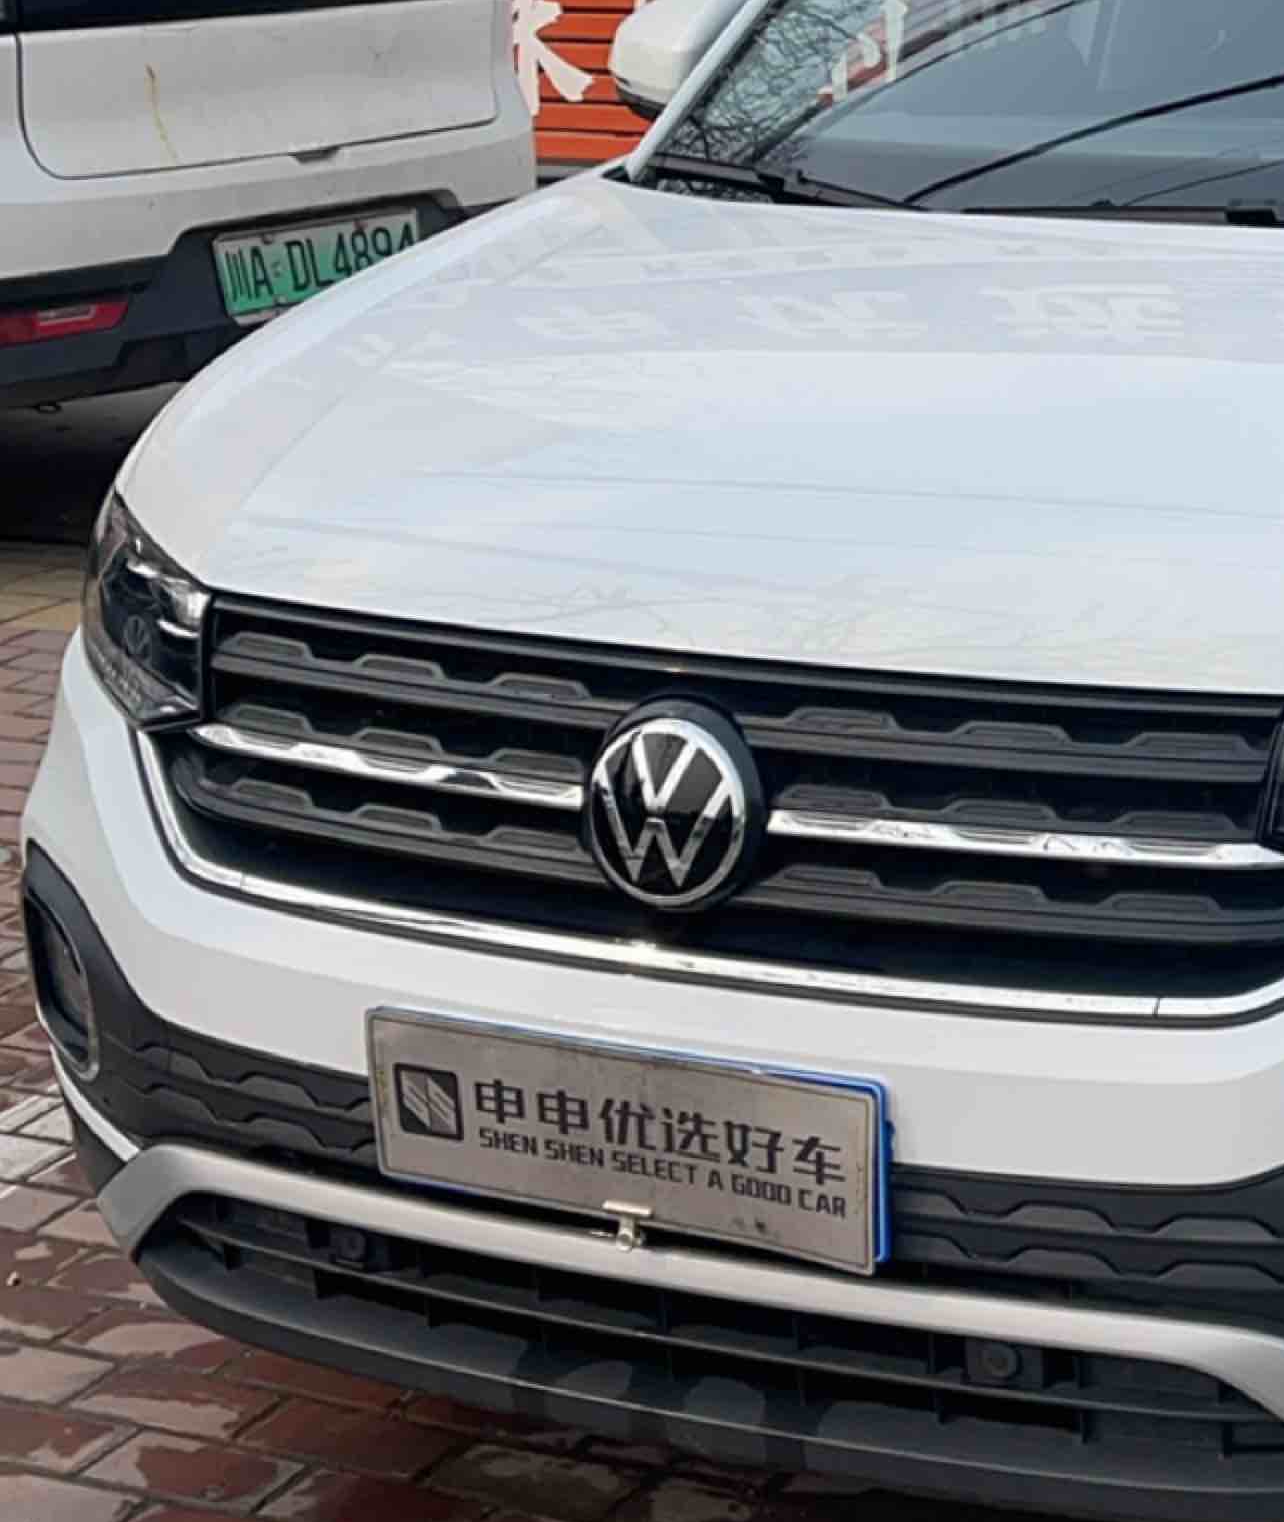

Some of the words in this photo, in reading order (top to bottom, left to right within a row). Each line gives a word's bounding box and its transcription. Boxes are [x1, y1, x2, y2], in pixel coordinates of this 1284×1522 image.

[474, 1079, 847, 1186] 申申优选好车
[478, 1127, 539, 1157] SHEN
[543, 1138, 603, 1168] SHEN
[611, 1150, 697, 1186] SELECT
[706, 1168, 724, 1192] A
[731, 1179, 792, 1207] GOOD
[799, 1191, 847, 1219] CAR
